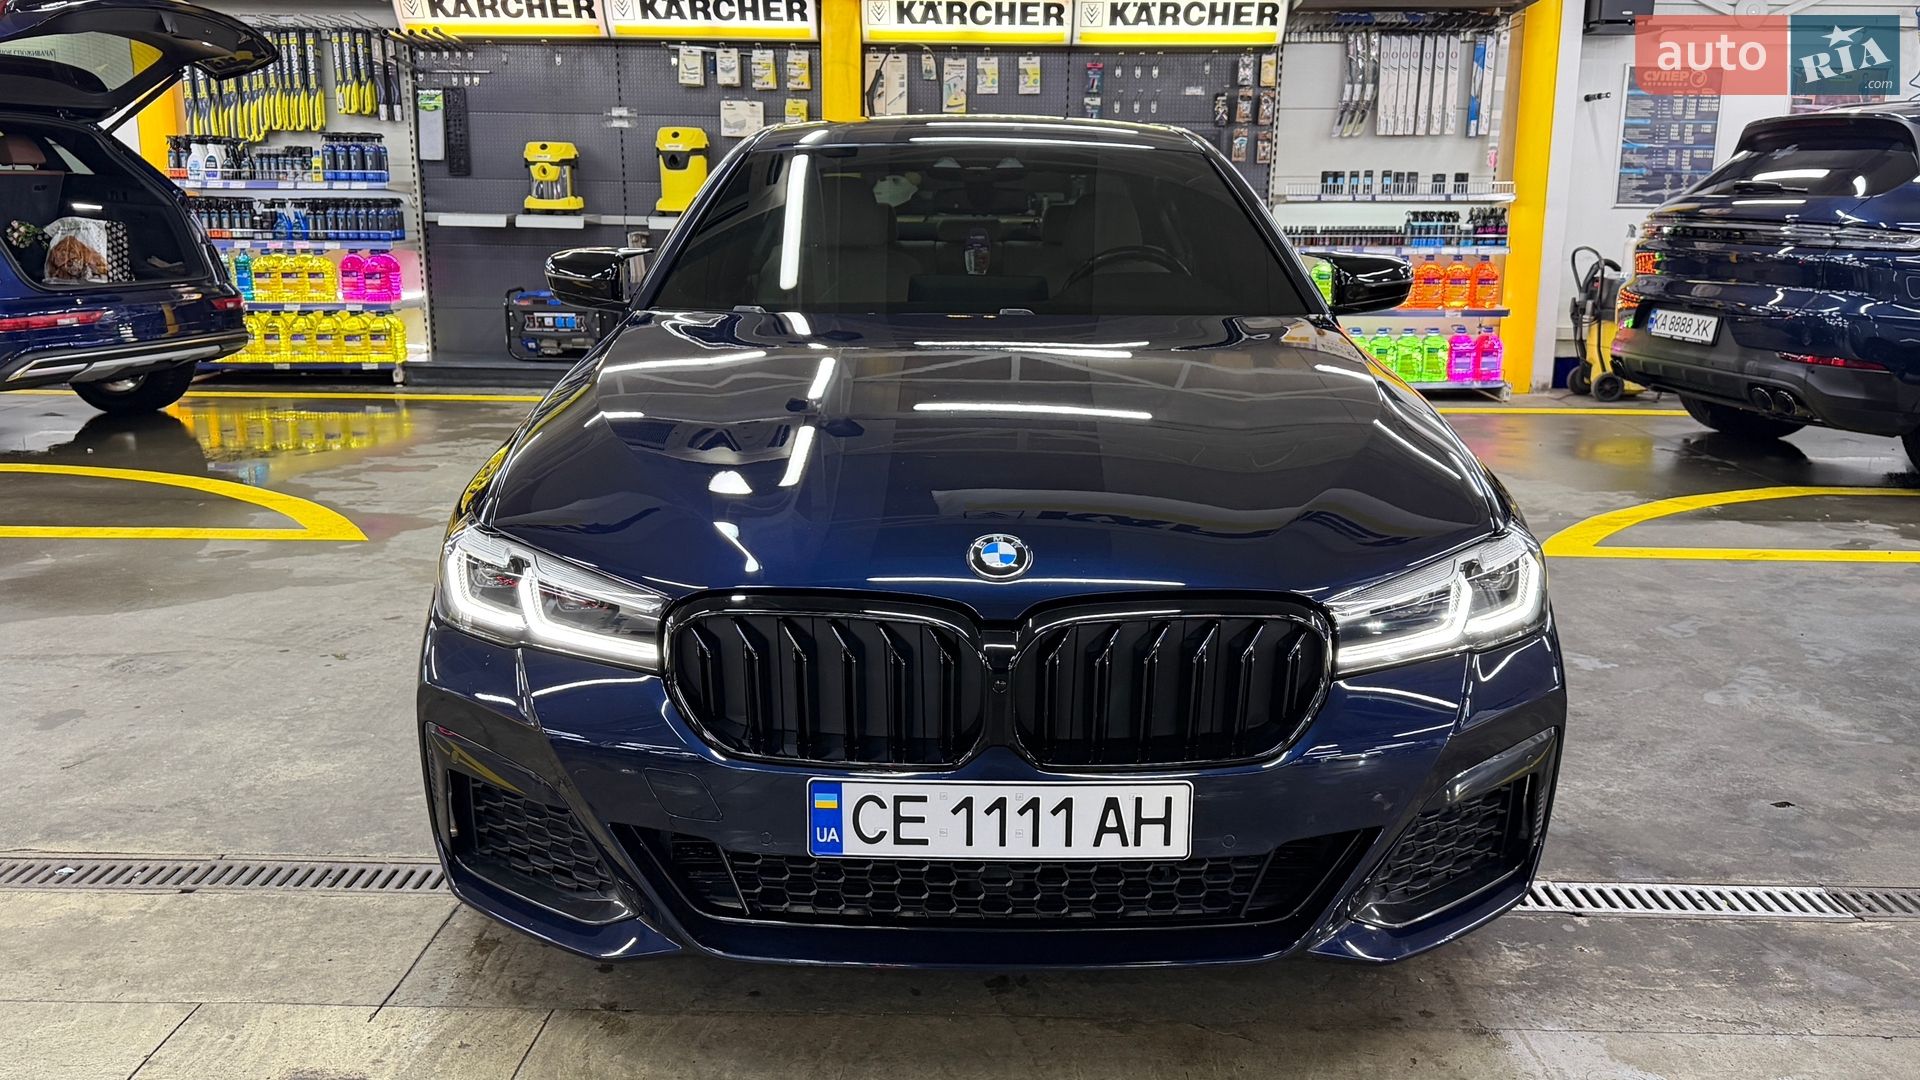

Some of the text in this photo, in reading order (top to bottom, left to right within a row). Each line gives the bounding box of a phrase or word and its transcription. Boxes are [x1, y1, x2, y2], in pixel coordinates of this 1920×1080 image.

[896, 0, 1065, 26] KÄRCHER
[1109, 1, 1280, 26] KÄRCHER
[1668, 315, 1694, 334] 8888
[1693, 318, 1713, 338] XK
[852, 795, 1173, 848] CE 1111 AH
[816, 827, 839, 843] UA
